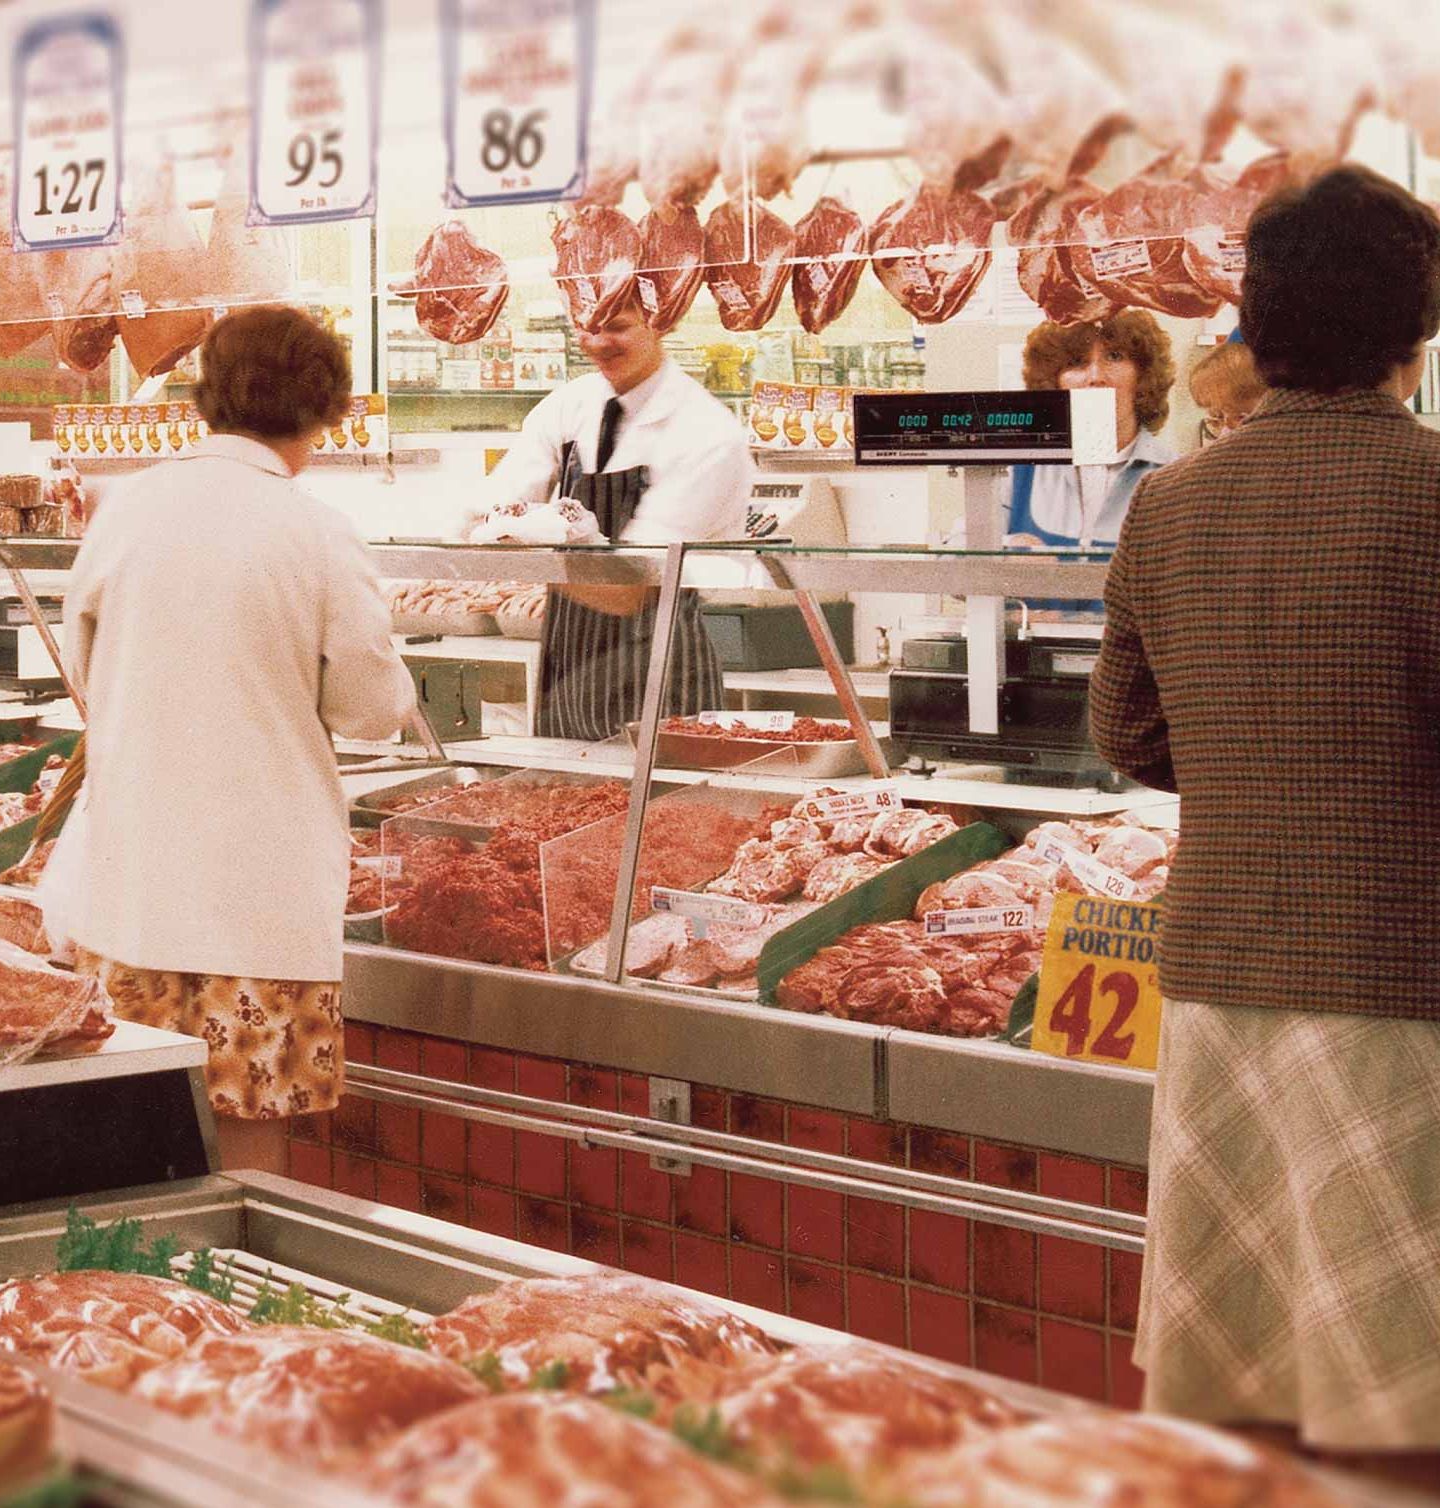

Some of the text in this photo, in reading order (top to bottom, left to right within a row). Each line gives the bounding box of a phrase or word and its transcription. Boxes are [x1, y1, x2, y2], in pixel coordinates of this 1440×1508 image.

[480, 107, 548, 172] 86
[285, 130, 344, 188] 95
[875, 791, 891, 807] 48
[1105, 875, 1125, 896] 128
[1002, 910, 1024, 928] 122
[1061, 926, 1159, 964] PORTIO
[1049, 963, 1140, 1061] 42
